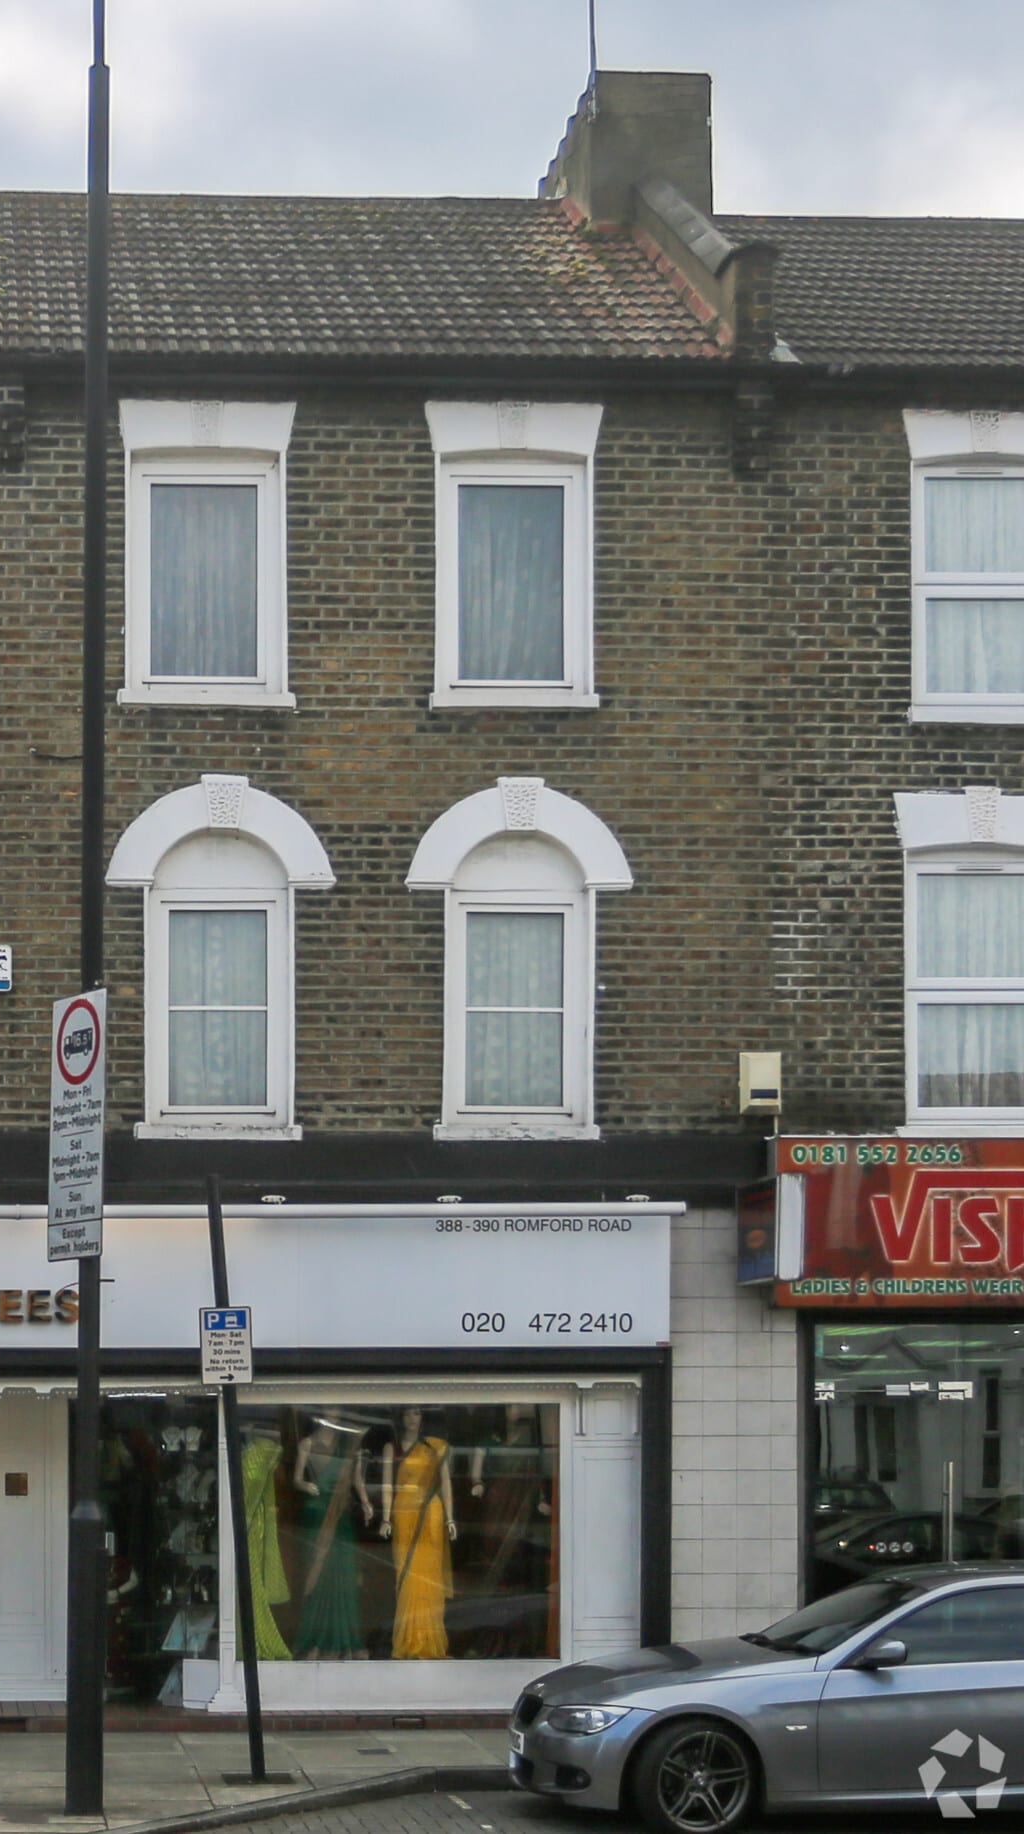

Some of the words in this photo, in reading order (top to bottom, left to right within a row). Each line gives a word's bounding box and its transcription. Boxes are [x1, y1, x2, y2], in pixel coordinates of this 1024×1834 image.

[70, 1139, 82, 1150] Sat
[791, 1144, 847, 1165] 0181
[856, 1144, 897, 1165] 552
[906, 1144, 962, 1165] 2656
[68, 1191, 81, 1202] Sun
[54, 1207, 63, 1218] At
[65, 1208, 77, 1218] any
[80, 1205, 96, 1215] time
[62, 1226, 86, 1239] Except
[504, 1218, 584, 1232] ROMFORD
[588, 1218, 632, 1232] ROAD
[50, 1243, 71, 1257] permit
[73, 1241, 99, 1253] holders
[791, 1278, 851, 1295] LADIES
[855, 1279, 870, 1295] &
[872, 1278, 967, 1295] CHILDRENS
[971, 1278, 1024, 1295] WEAR
[207, 1313, 220, 1329] P
[461, 1312, 506, 1333] 020
[528, 1312, 572, 1333] 472
[579, 1312, 633, 1333] 2410
